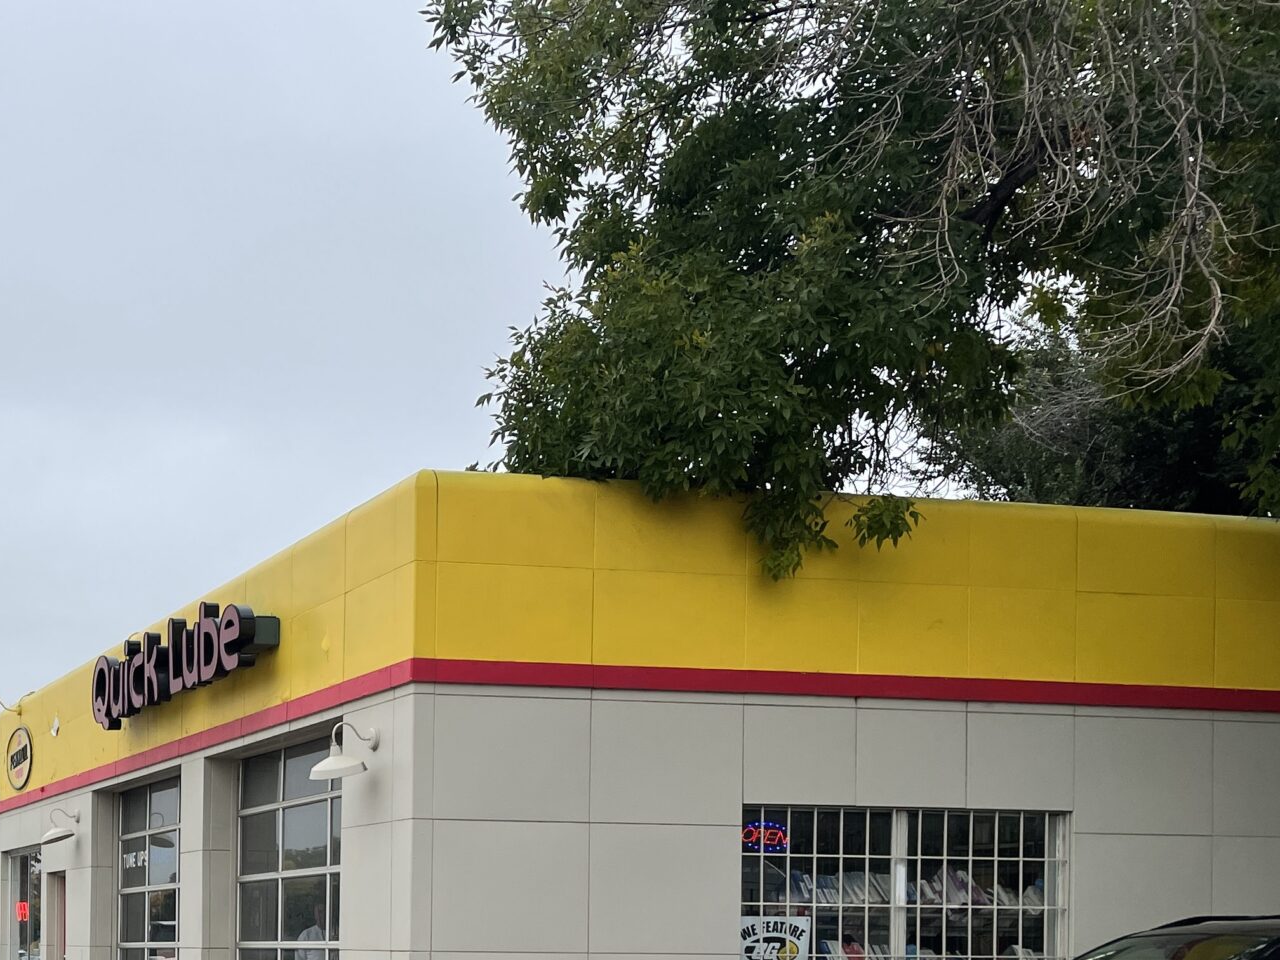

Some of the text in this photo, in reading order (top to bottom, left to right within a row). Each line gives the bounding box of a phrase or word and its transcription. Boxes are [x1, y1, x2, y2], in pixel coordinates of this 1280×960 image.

[92, 601, 241, 730] Quick Lube
[740, 923, 758, 941] WE
